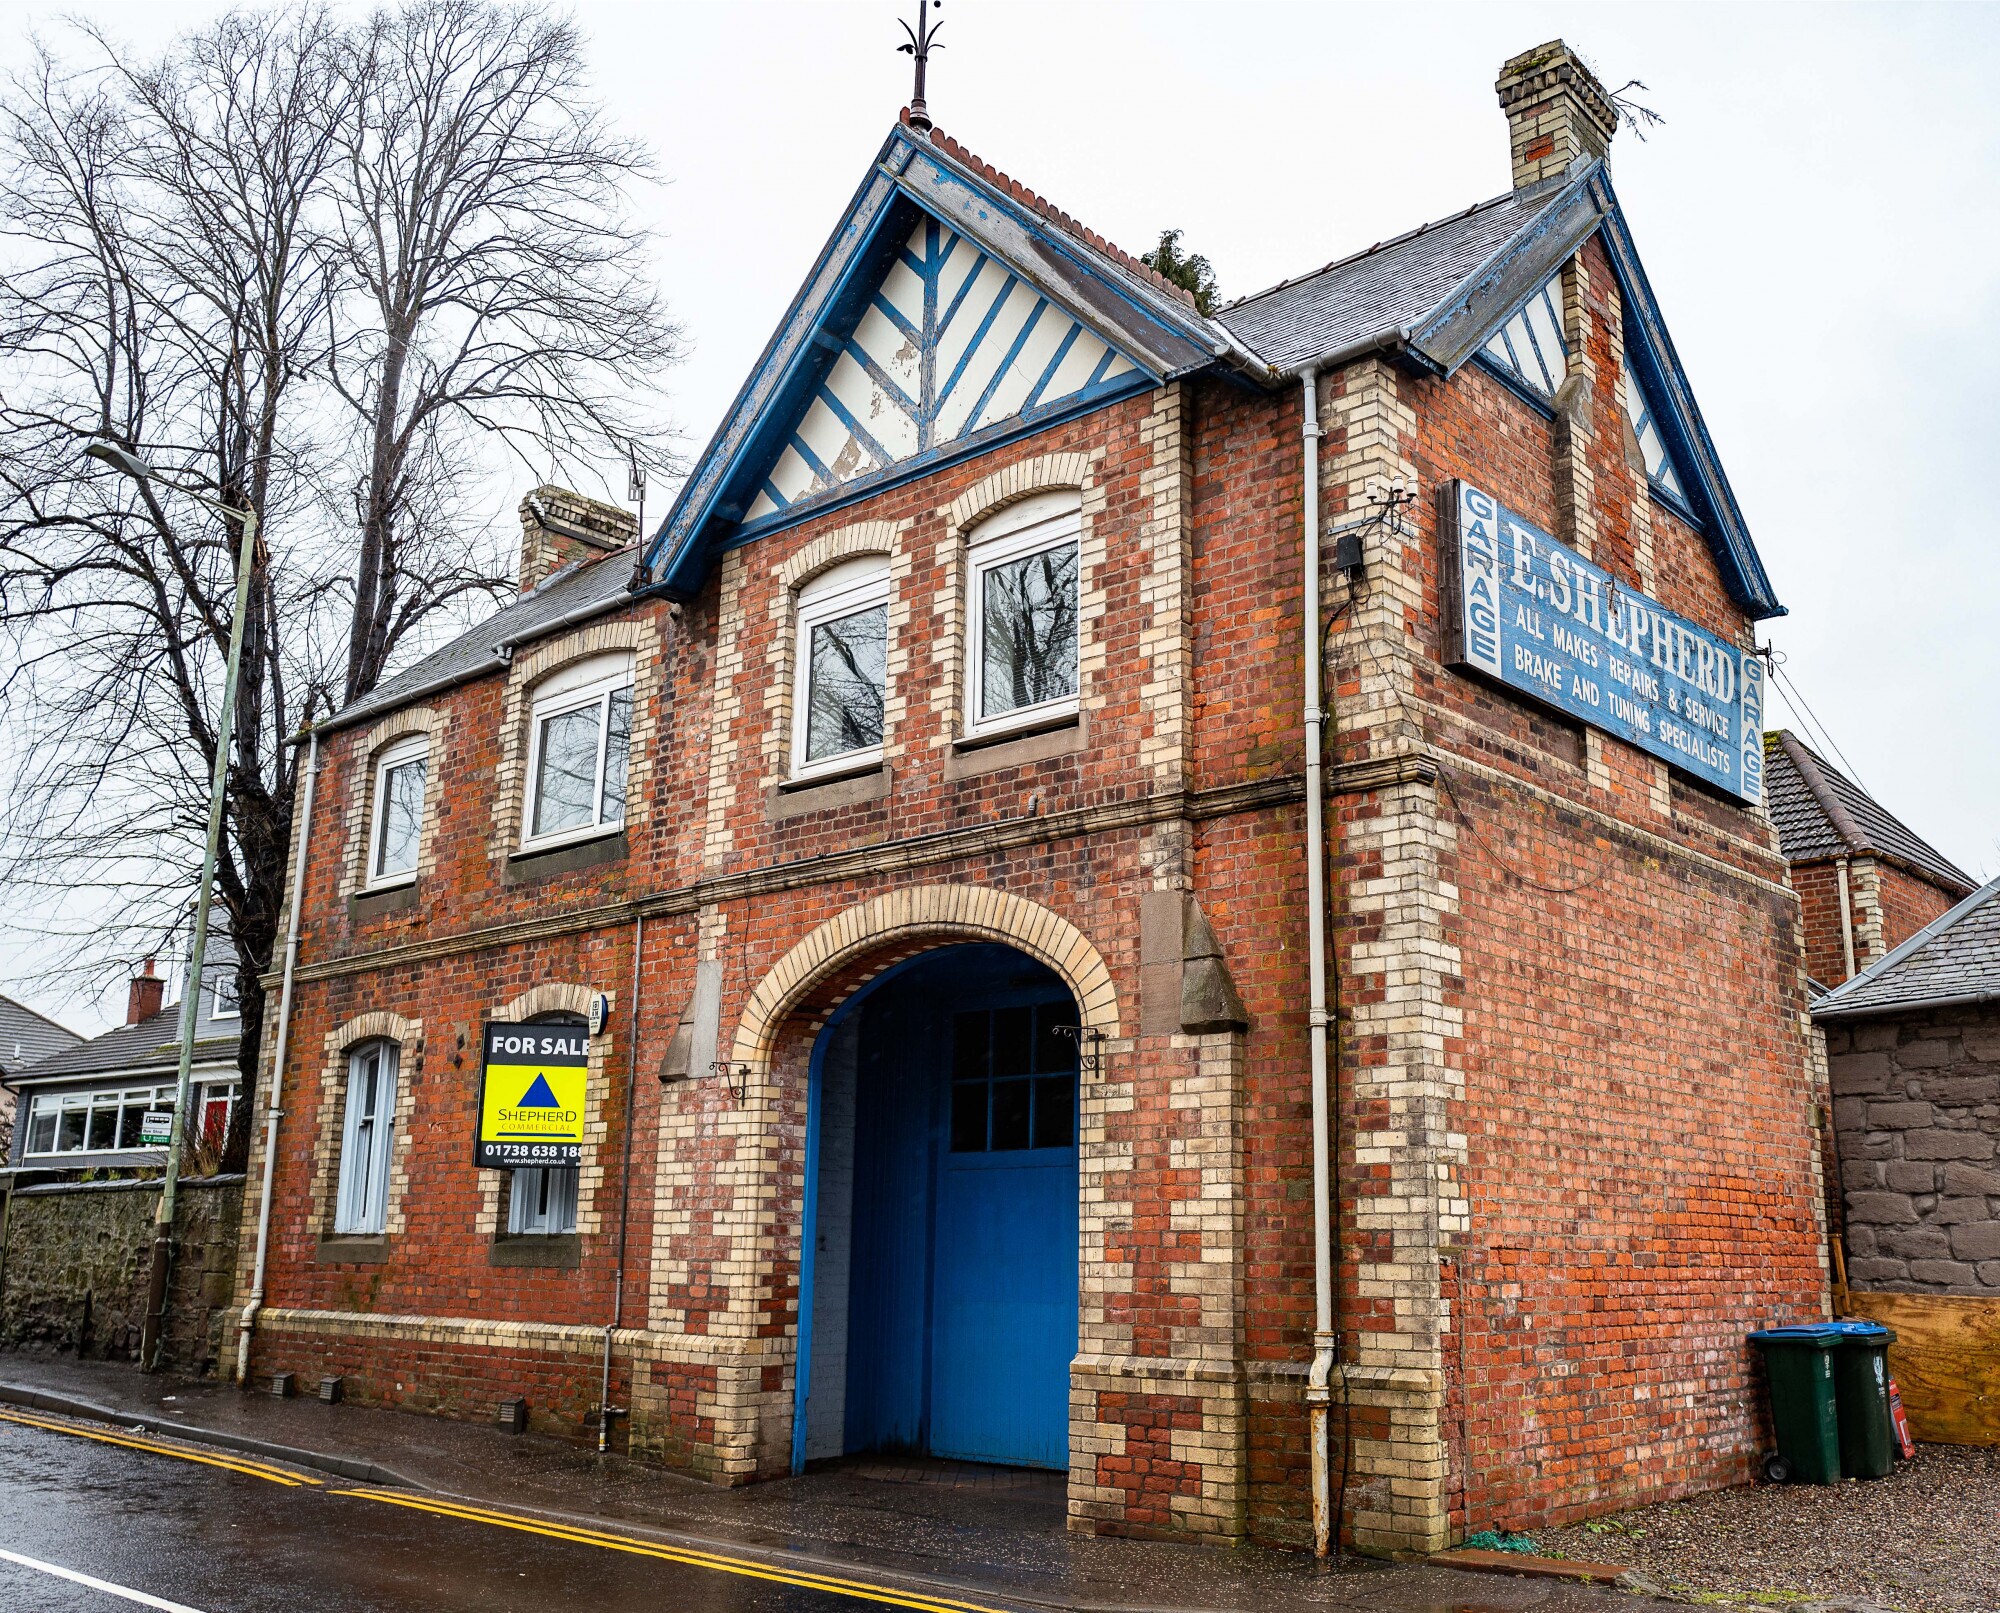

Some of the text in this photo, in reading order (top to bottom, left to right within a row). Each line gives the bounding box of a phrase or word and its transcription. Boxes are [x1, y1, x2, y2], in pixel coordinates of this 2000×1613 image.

[1465, 488, 1496, 665] GARAGE
[1516, 603, 1729, 740] ALL MAKES REPAIRS & SERVICE
[1514, 643, 1730, 774] BRAKE AND TUNING SPECIALISTS
[1743, 656, 1762, 797] GARAGE
[491, 1036, 590, 1056] FOR SALE
[498, 1108, 577, 1122] SHEPHERD
[501, 1123, 571, 1132] COMMERCIAL
[485, 1144, 529, 1156] 01738
[531, 1145, 558, 1157] 638
[503, 1157, 566, 1166] www.shepherd.co.uk
